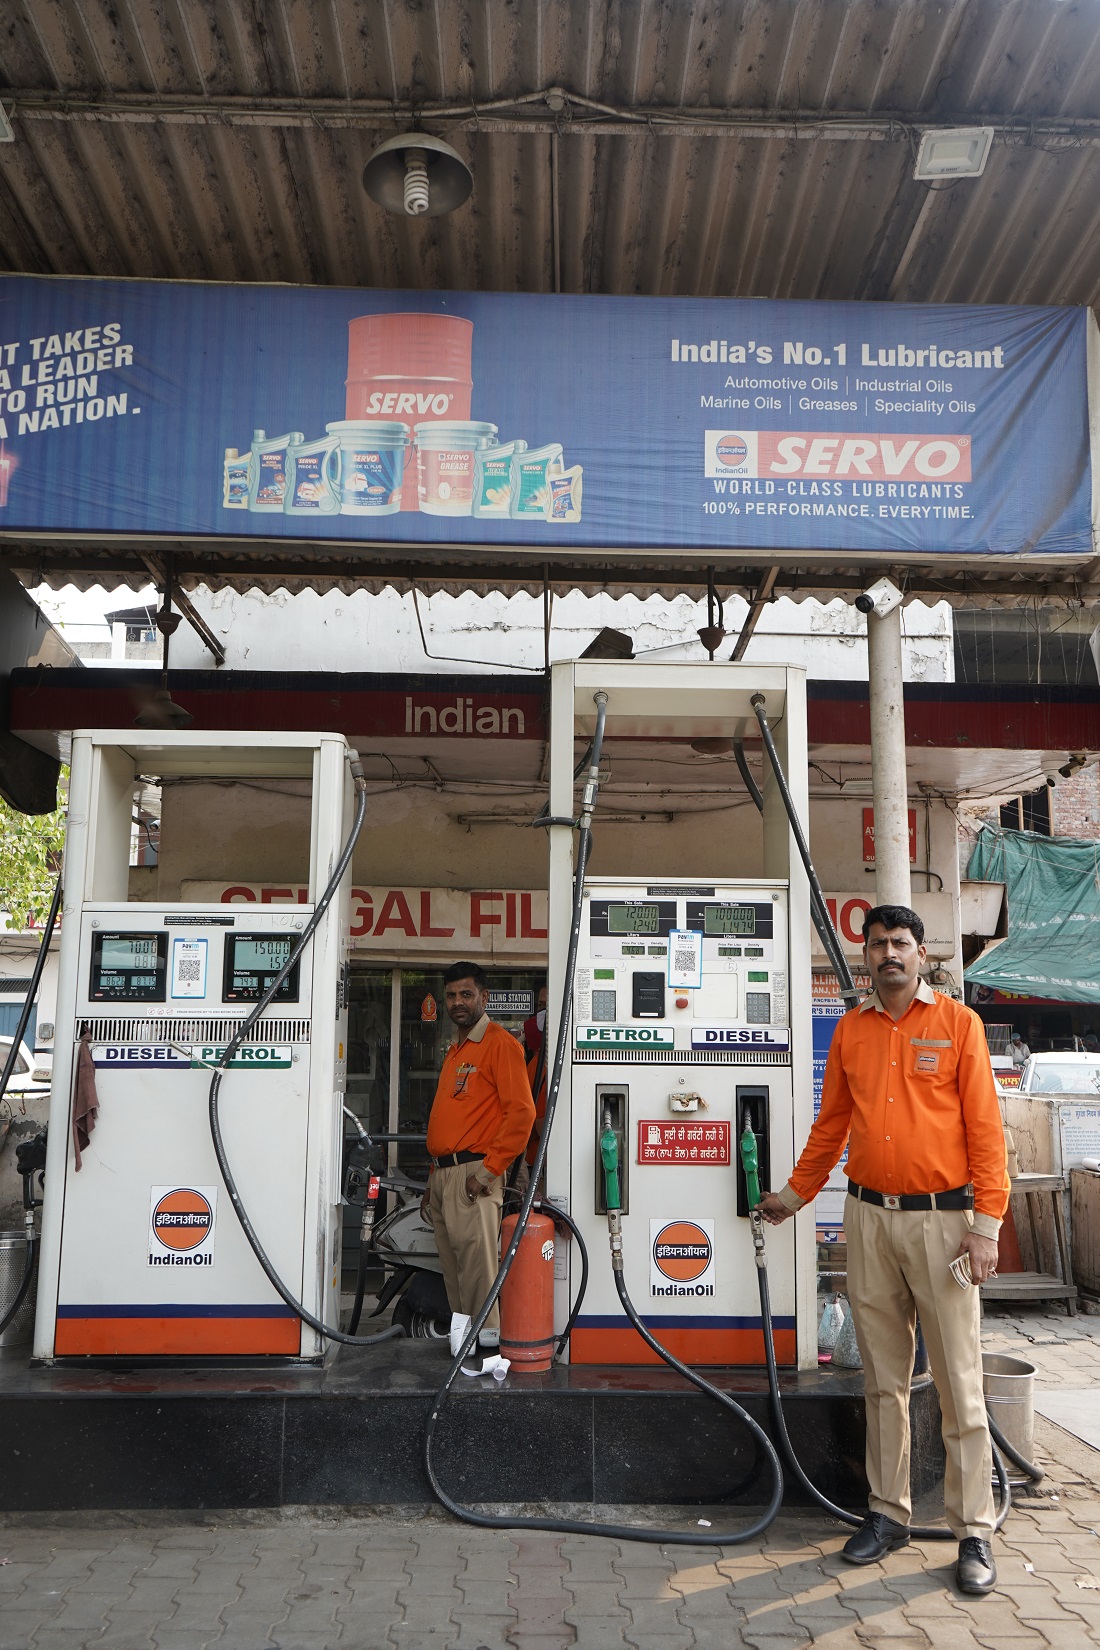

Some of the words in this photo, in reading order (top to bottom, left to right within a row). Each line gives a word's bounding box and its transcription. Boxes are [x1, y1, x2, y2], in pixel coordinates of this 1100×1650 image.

[29, 323, 121, 360] TAKES
[671, 339, 773, 364] India's
[783, 342, 847, 366] No.1
[861, 343, 1005, 368] Lubricant
[0, 369, 11, 390] A
[21, 344, 134, 386] LEADER
[724, 376, 807, 389] Automotive
[811, 377, 839, 390] Oils
[855, 378, 921, 392] Industrial
[925, 380, 953, 392] Oils
[0, 390, 26, 415] TO
[36, 375, 98, 407] RUN
[700, 395, 750, 408] Marine
[754, 396, 782, 409] Oils
[798, 397, 858, 411] Greases
[874, 399, 945, 416] Speciality
[948, 400, 976, 413] Oils
[18, 393, 141, 435] NATION.
[352, 454, 377, 463] SERVO
[440, 462, 469, 470] GREASE
[713, 480, 843, 496] WORLD-CLASS
[852, 482, 964, 498] LUBRICANTS
[702, 502, 740, 515] 100%
[745, 502, 875, 518] PERFORMANCE.
[879, 505, 975, 519] EVERYTIME.
[404, 697, 525, 734] Indian
[508, 993, 531, 1003] STATION
[586, 1029, 664, 1041] PETROL
[705, 1031, 775, 1043] DIESEL
[105, 1048, 178, 1060] DIESEL
[156, 1213, 209, 1226] इंडियनऑयल
[657, 1245, 708, 1258] इंडियनऑयल
[149, 1254, 212, 1265] IndianOil
[652, 1285, 714, 1296] IndianOil
